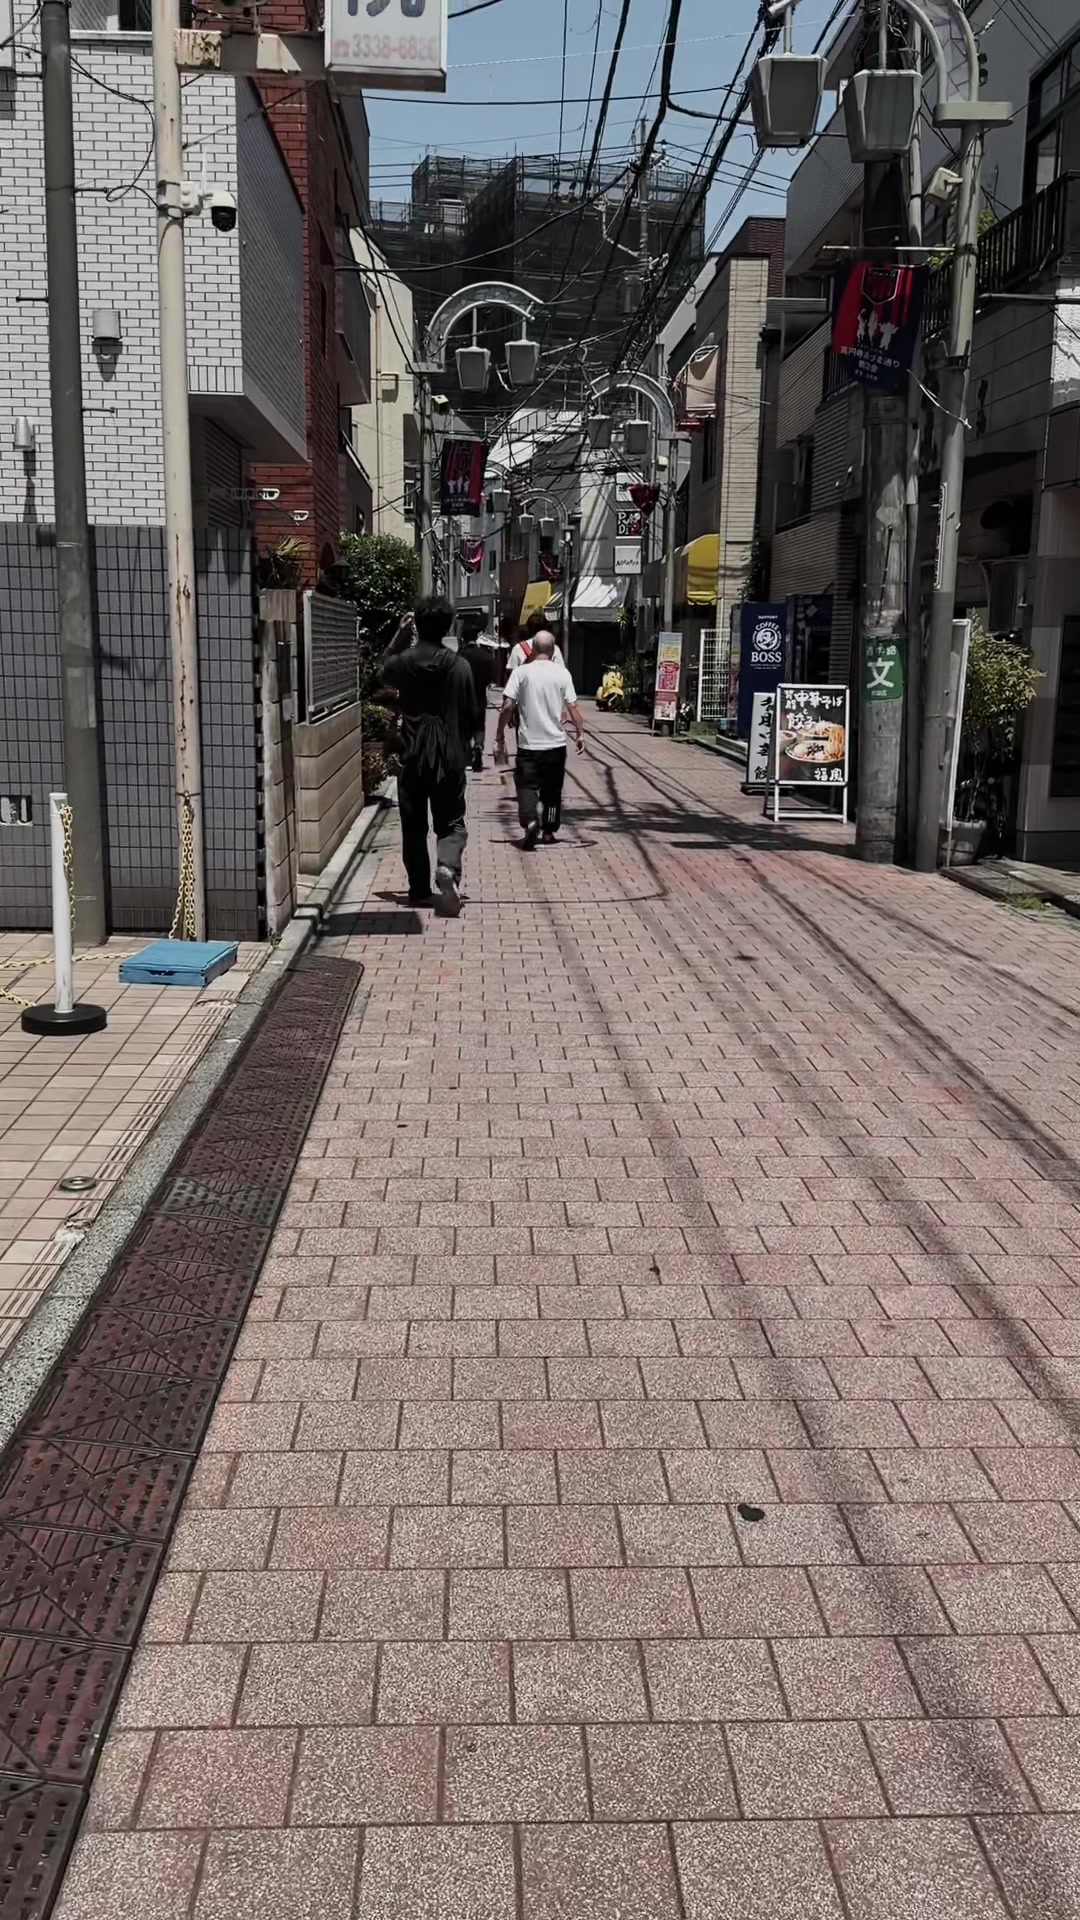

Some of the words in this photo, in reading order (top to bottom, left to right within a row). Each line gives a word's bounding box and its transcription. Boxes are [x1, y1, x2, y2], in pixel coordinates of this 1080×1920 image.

[755, 621, 780, 631] COFFEE
[751, 651, 782, 663] BOSS
[867, 656, 895, 689] 文
